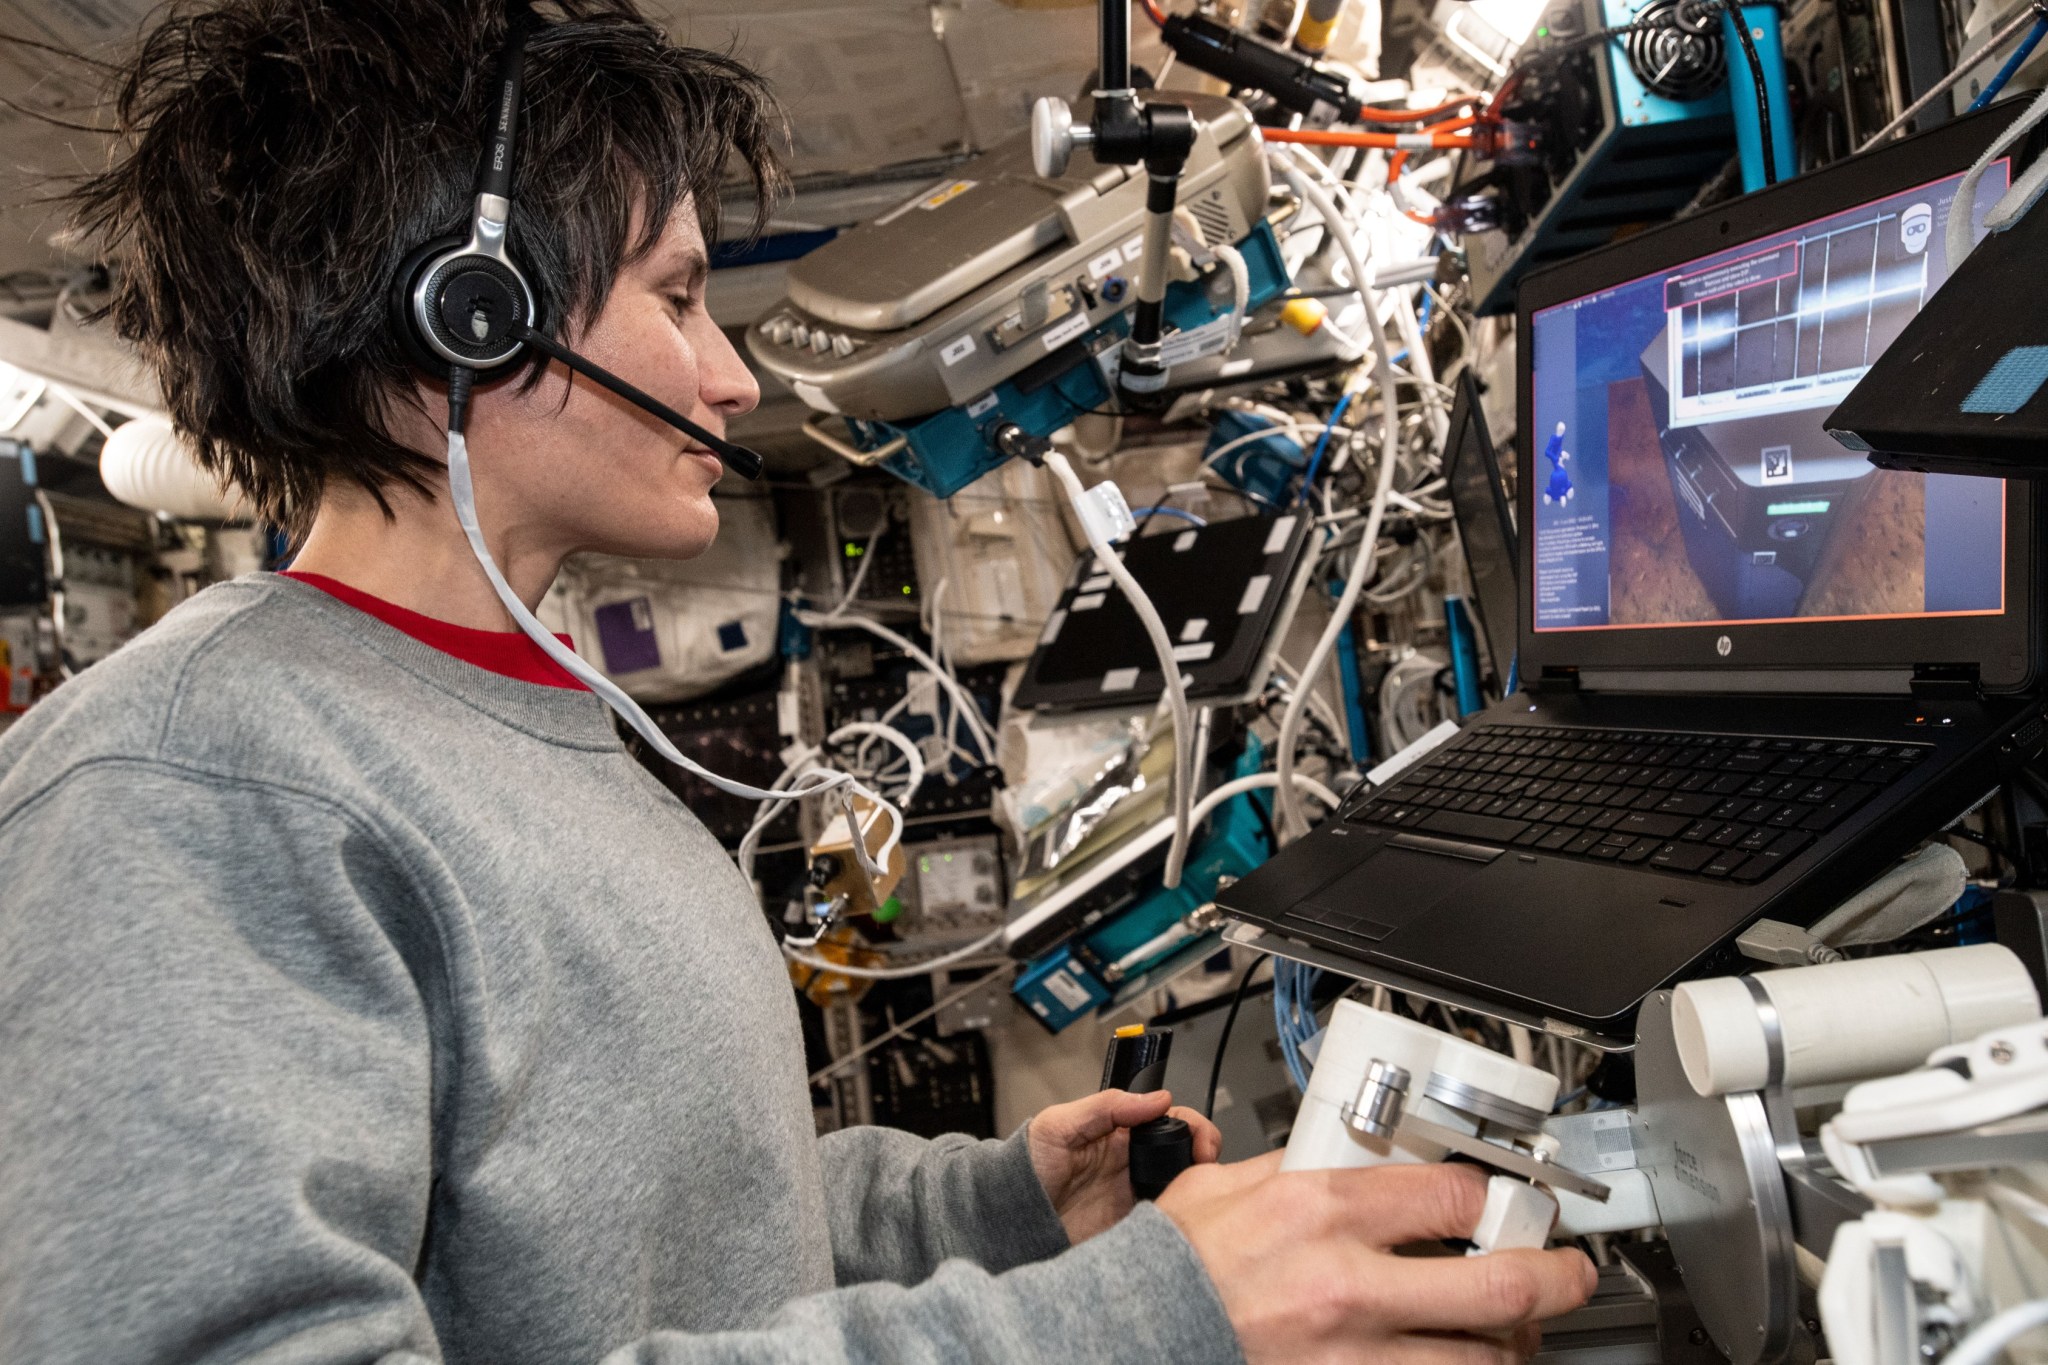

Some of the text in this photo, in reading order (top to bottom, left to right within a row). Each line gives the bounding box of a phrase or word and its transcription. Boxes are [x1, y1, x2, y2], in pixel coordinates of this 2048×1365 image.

[493, 80, 513, 172] EPOS SENNHEISER
[1717, 635, 1732, 656] hp
